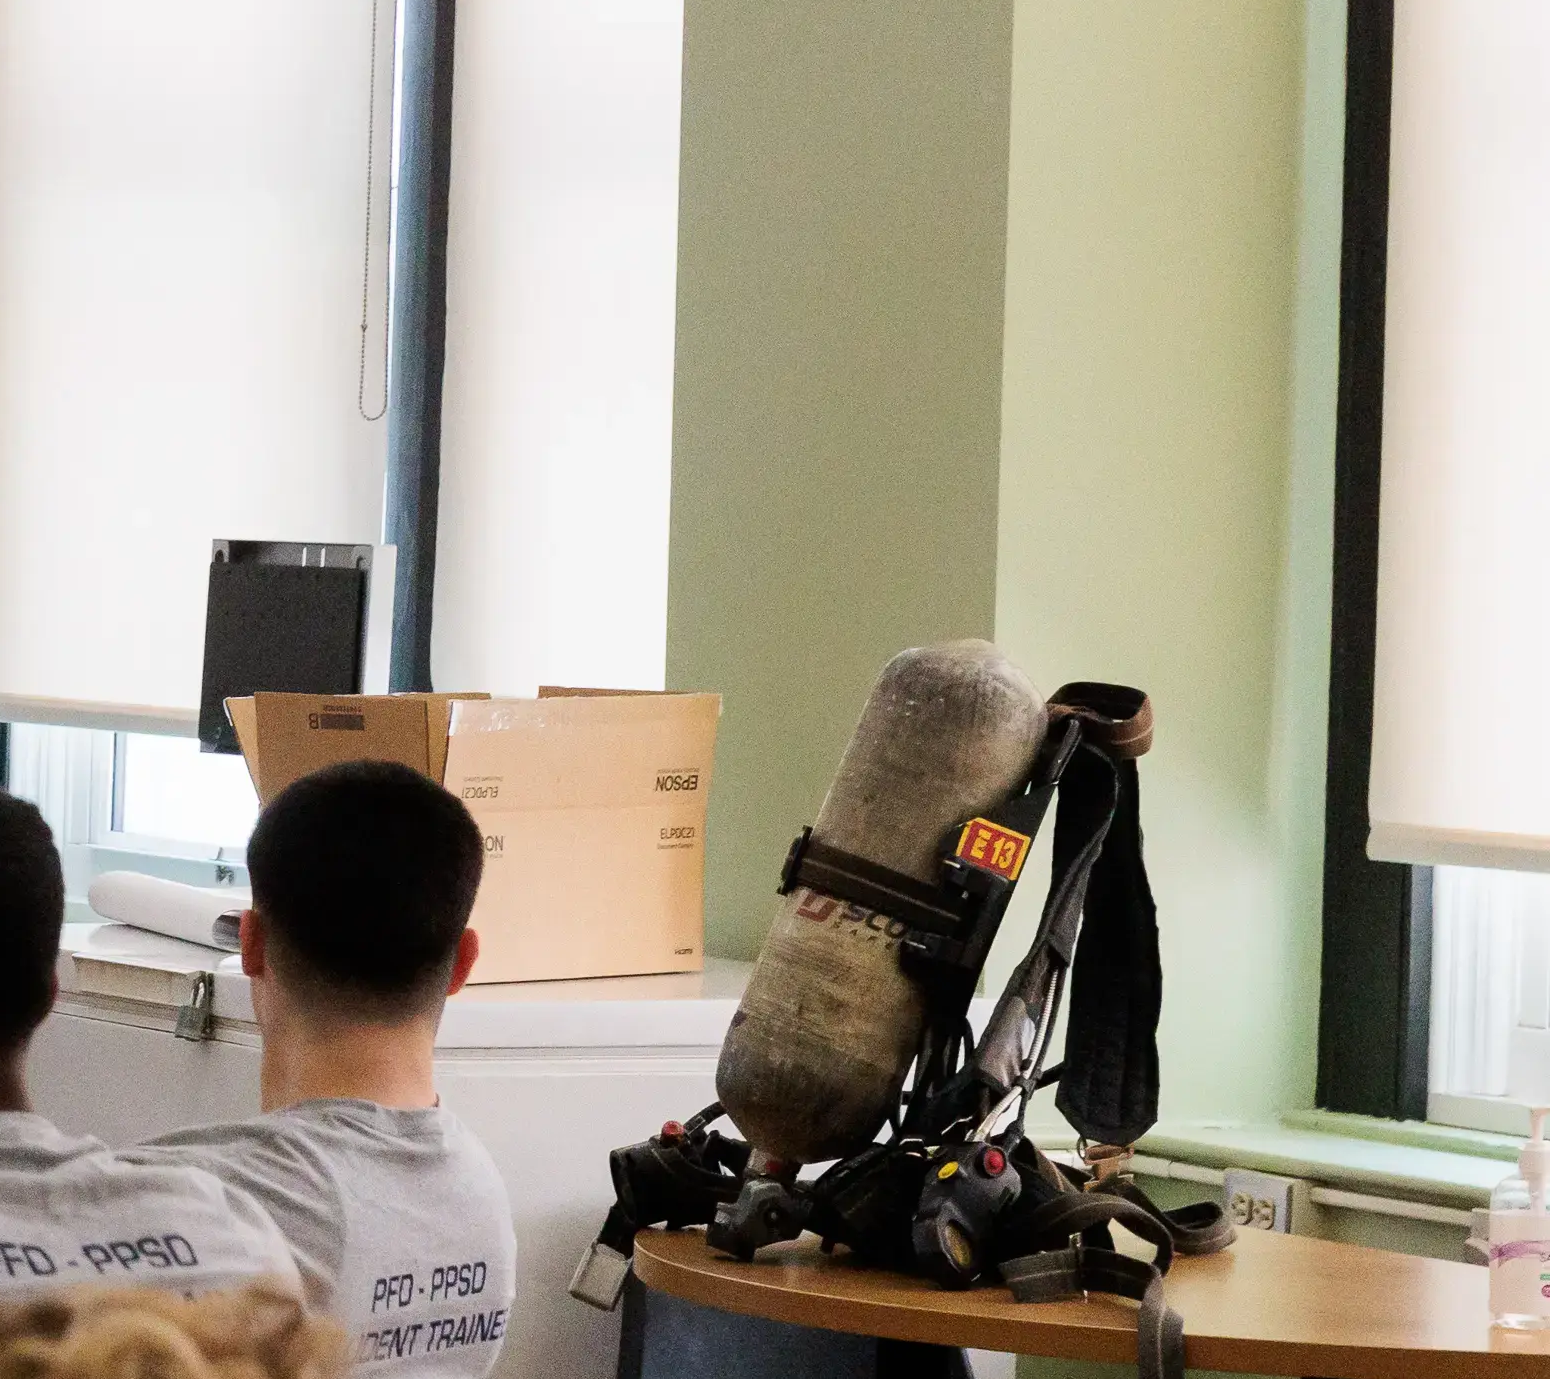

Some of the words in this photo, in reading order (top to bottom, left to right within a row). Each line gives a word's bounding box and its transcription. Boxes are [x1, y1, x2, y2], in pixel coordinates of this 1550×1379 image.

[655, 775, 699, 792] EPSON
[970, 828, 992, 860] E
[990, 837, 1017, 869] 13
[81, 1232, 199, 1275] PPSD
[371, 1273, 414, 1313] PFD
[430, 1261, 487, 1302] PPSD
[354, 1324, 423, 1364] DENT
[427, 1309, 508, 1353] TRAINE
